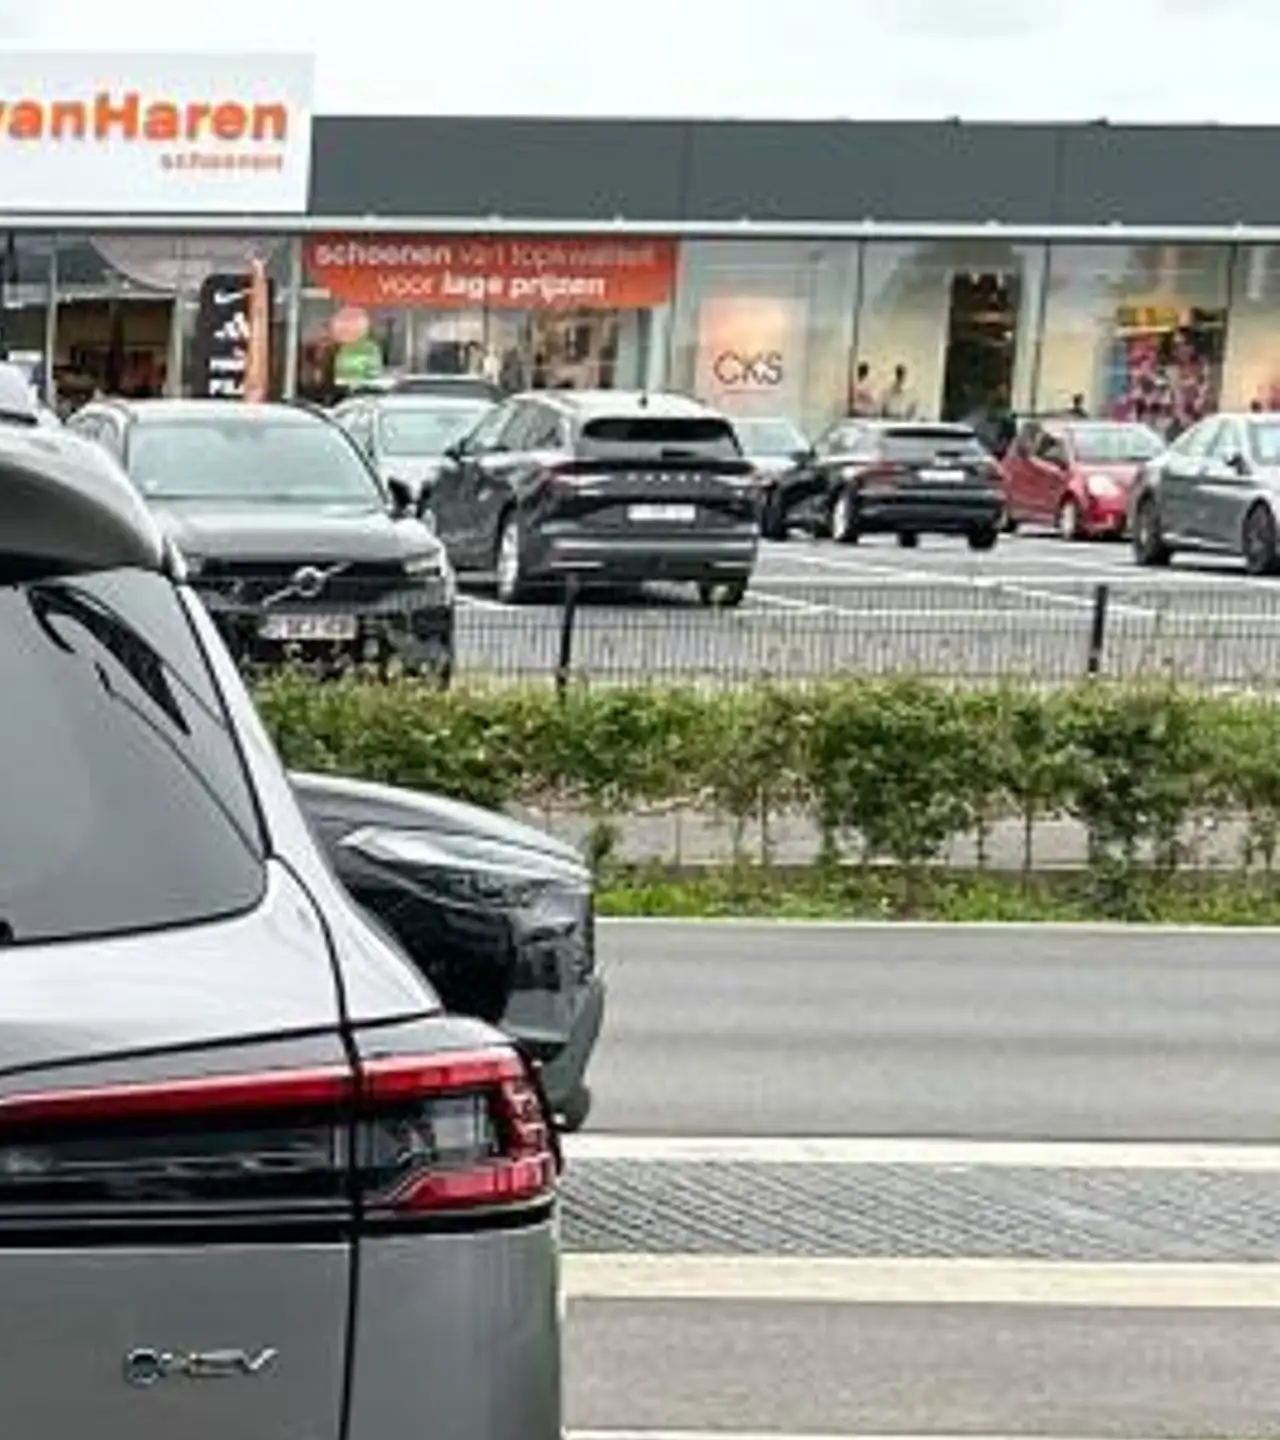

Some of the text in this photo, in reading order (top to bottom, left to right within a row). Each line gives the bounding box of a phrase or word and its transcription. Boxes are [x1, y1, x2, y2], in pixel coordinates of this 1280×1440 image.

[314, 241, 452, 266] schoenen
[376, 269, 606, 303] voor lage prijzen
[713, 349, 783, 385] CKS
